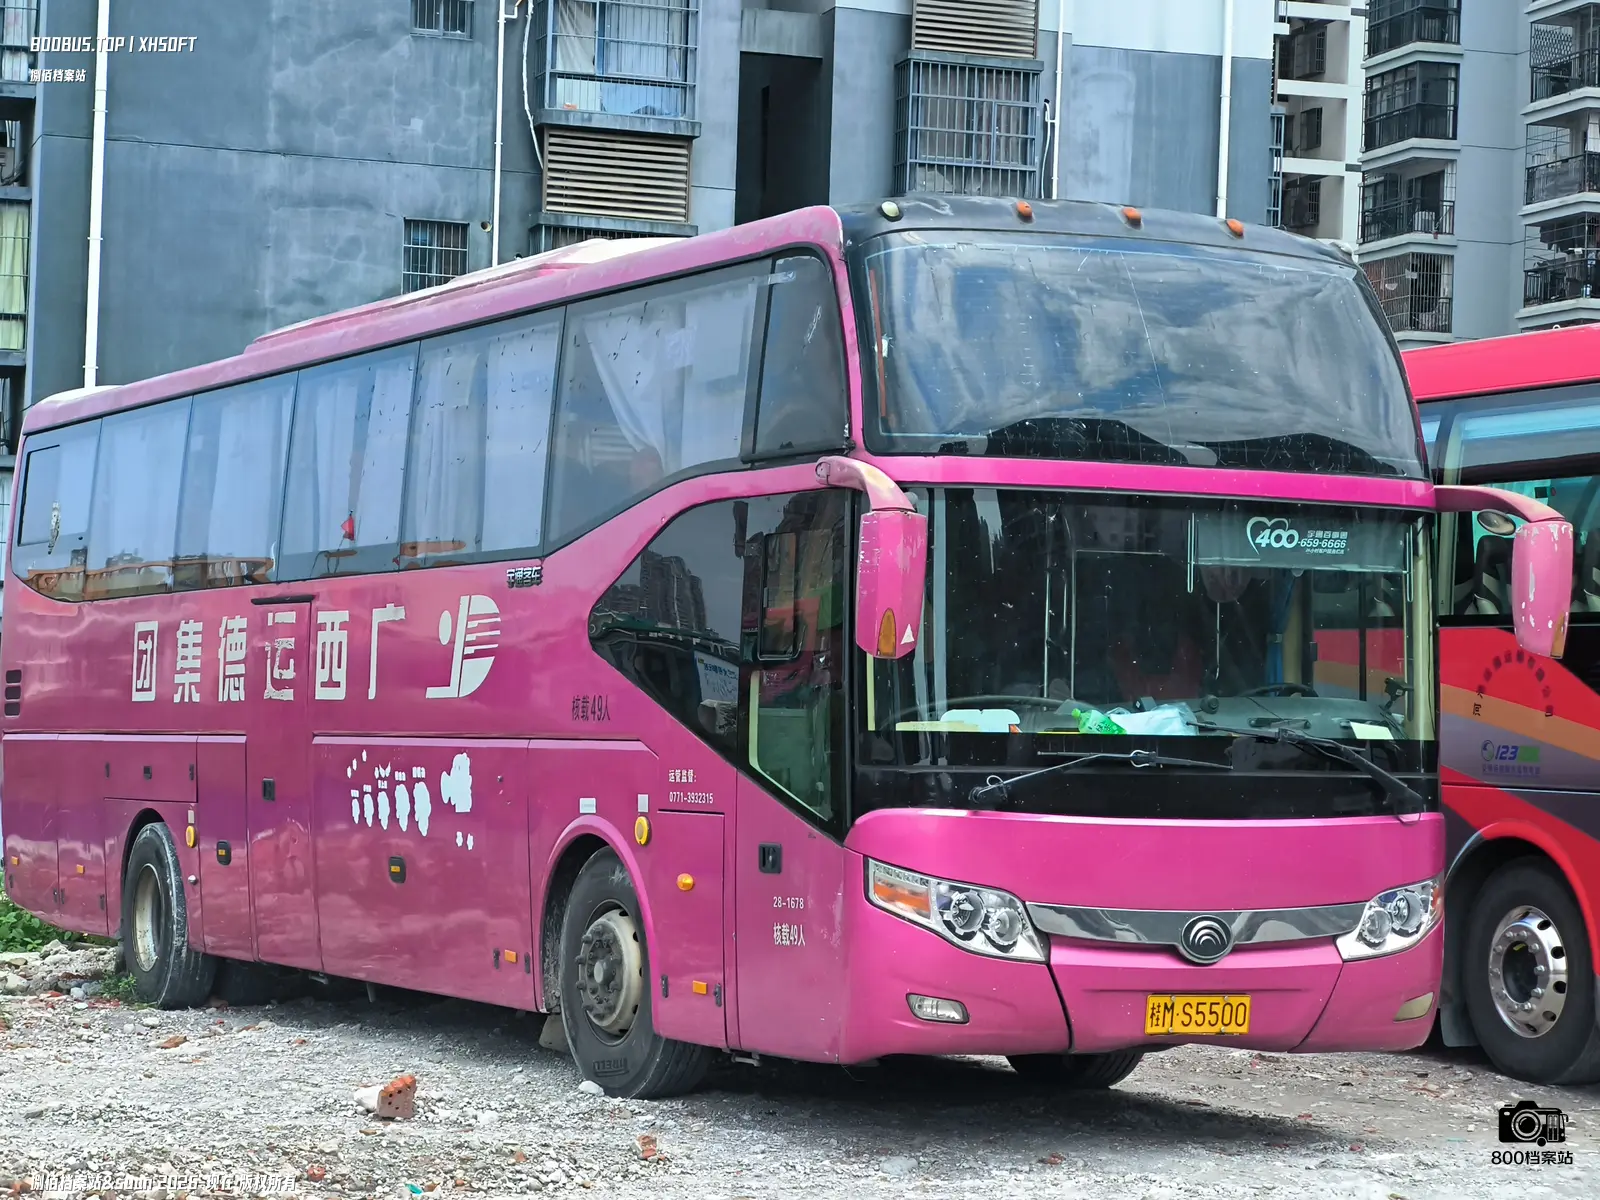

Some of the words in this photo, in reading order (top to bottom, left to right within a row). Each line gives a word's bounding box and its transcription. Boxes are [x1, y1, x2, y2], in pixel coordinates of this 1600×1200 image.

[572, 695, 611, 721] 核载49人
[669, 792, 714, 804] 0771-3932315
[773, 896, 805, 909] 28-1678
[773, 923, 806, 946] 核载49人
